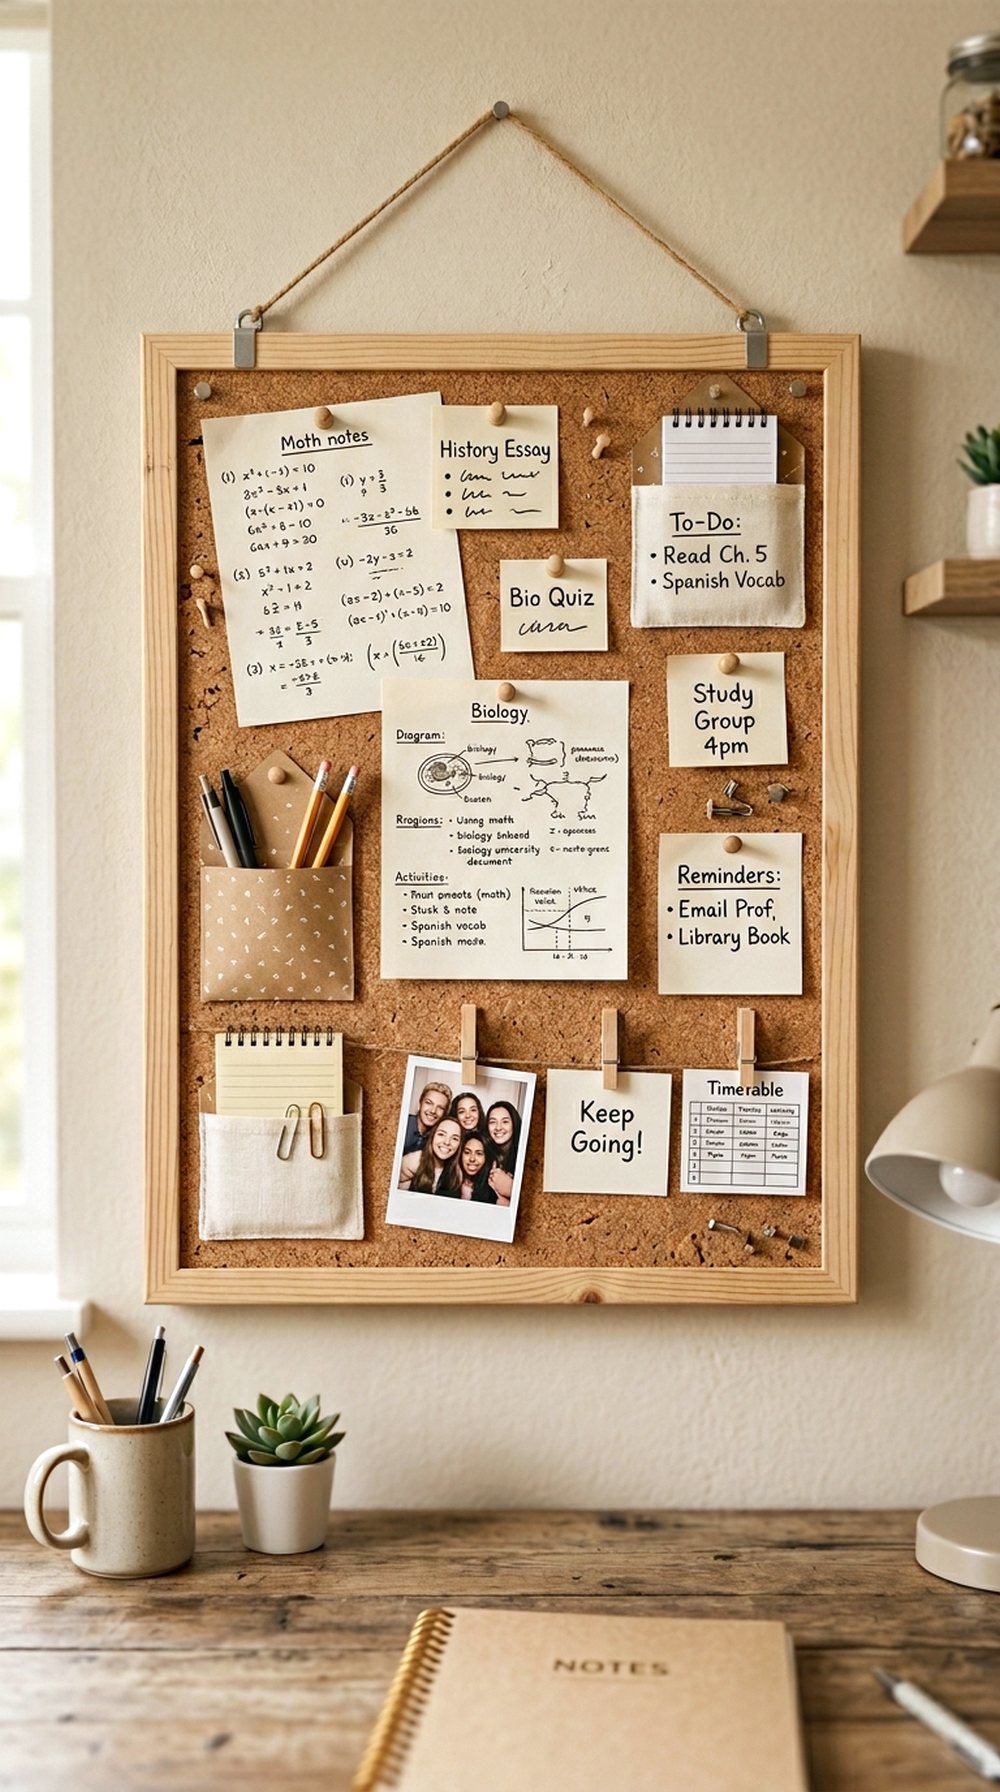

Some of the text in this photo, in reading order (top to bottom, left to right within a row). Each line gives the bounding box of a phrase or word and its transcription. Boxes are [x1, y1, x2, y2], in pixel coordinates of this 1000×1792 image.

[327, 429, 369, 446] notes
[440, 439, 551, 464] History Essay
[303, 463, 315, 473] 10
[670, 511, 741, 532] To-Do:
[664, 544, 768, 565] Read Ch. 5
[663, 570, 786, 595] Spanish Vocab
[440, 602, 451, 612] 10
[510, 587, 595, 607] Bio Quiz
[693, 682, 753, 709] Study
[694, 709, 756, 735] Group
[704, 736, 749, 760] 4pm
[678, 865, 781, 884] Reminders:
[455, 905, 478, 914] note
[679, 898, 727, 918] Email
[679, 926, 791, 952] Library Book
[581, 1100, 634, 1131] Keep
[571, 1130, 642, 1163] Going!
[553, 1659, 670, 1676] NOTES
